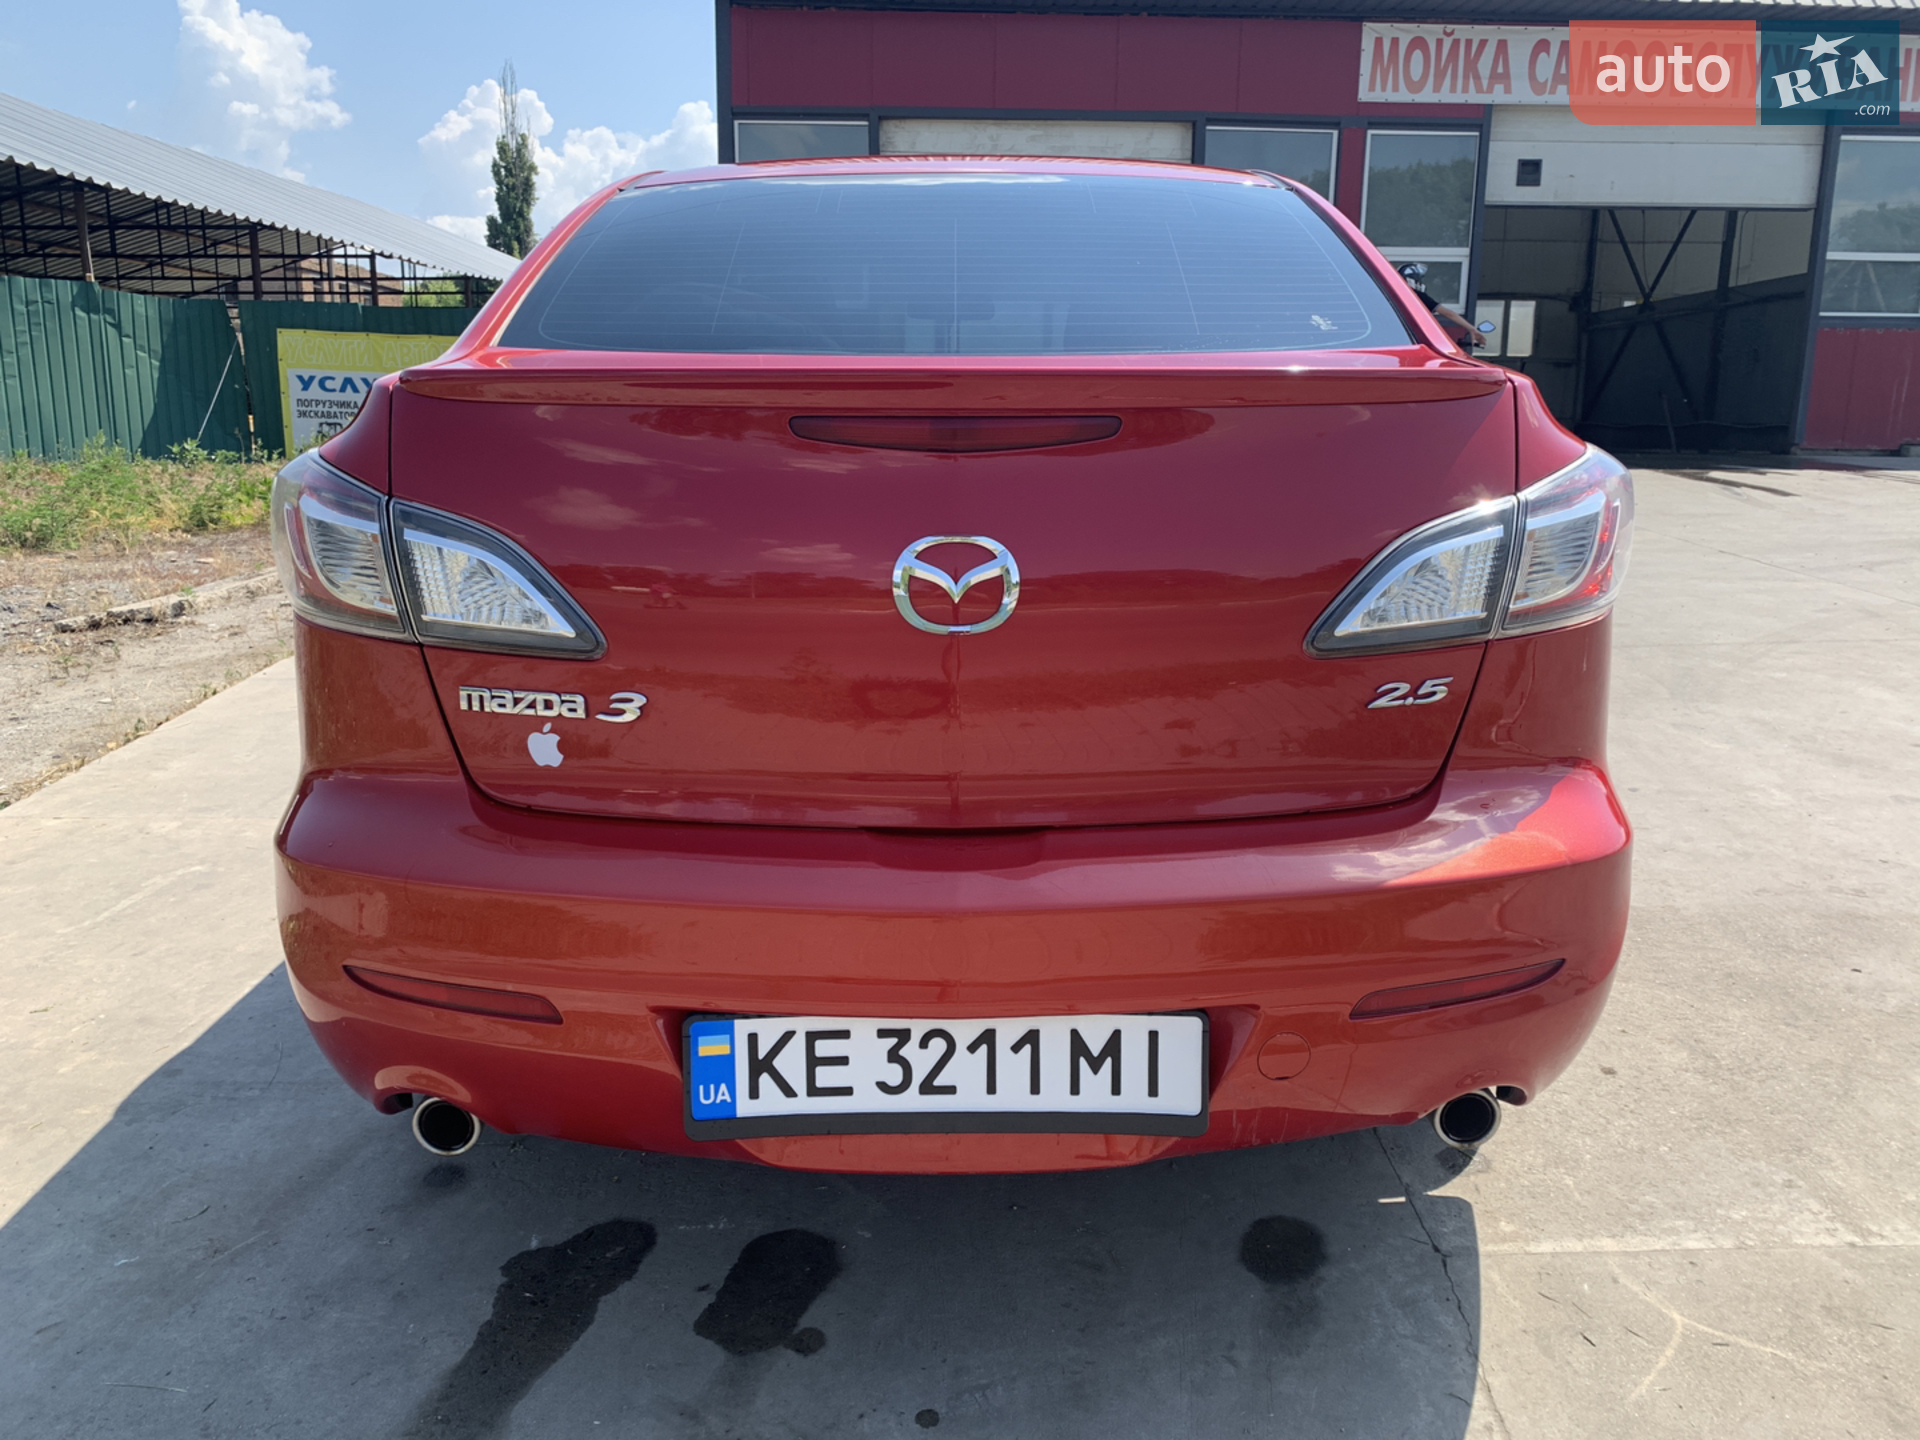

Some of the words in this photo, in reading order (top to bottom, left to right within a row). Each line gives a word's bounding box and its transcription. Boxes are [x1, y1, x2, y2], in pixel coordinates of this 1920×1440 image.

[1368, 28, 1512, 95] МОЙКА
[284, 336, 373, 366] УСЛУГИ
[595, 692, 648, 723] 3
[1367, 676, 1454, 709] 2.5
[747, 1029, 855, 1100] KE
[875, 1028, 1041, 1096] 3211
[1070, 1028, 1160, 1098] MI
[699, 1083, 732, 1104] UA
